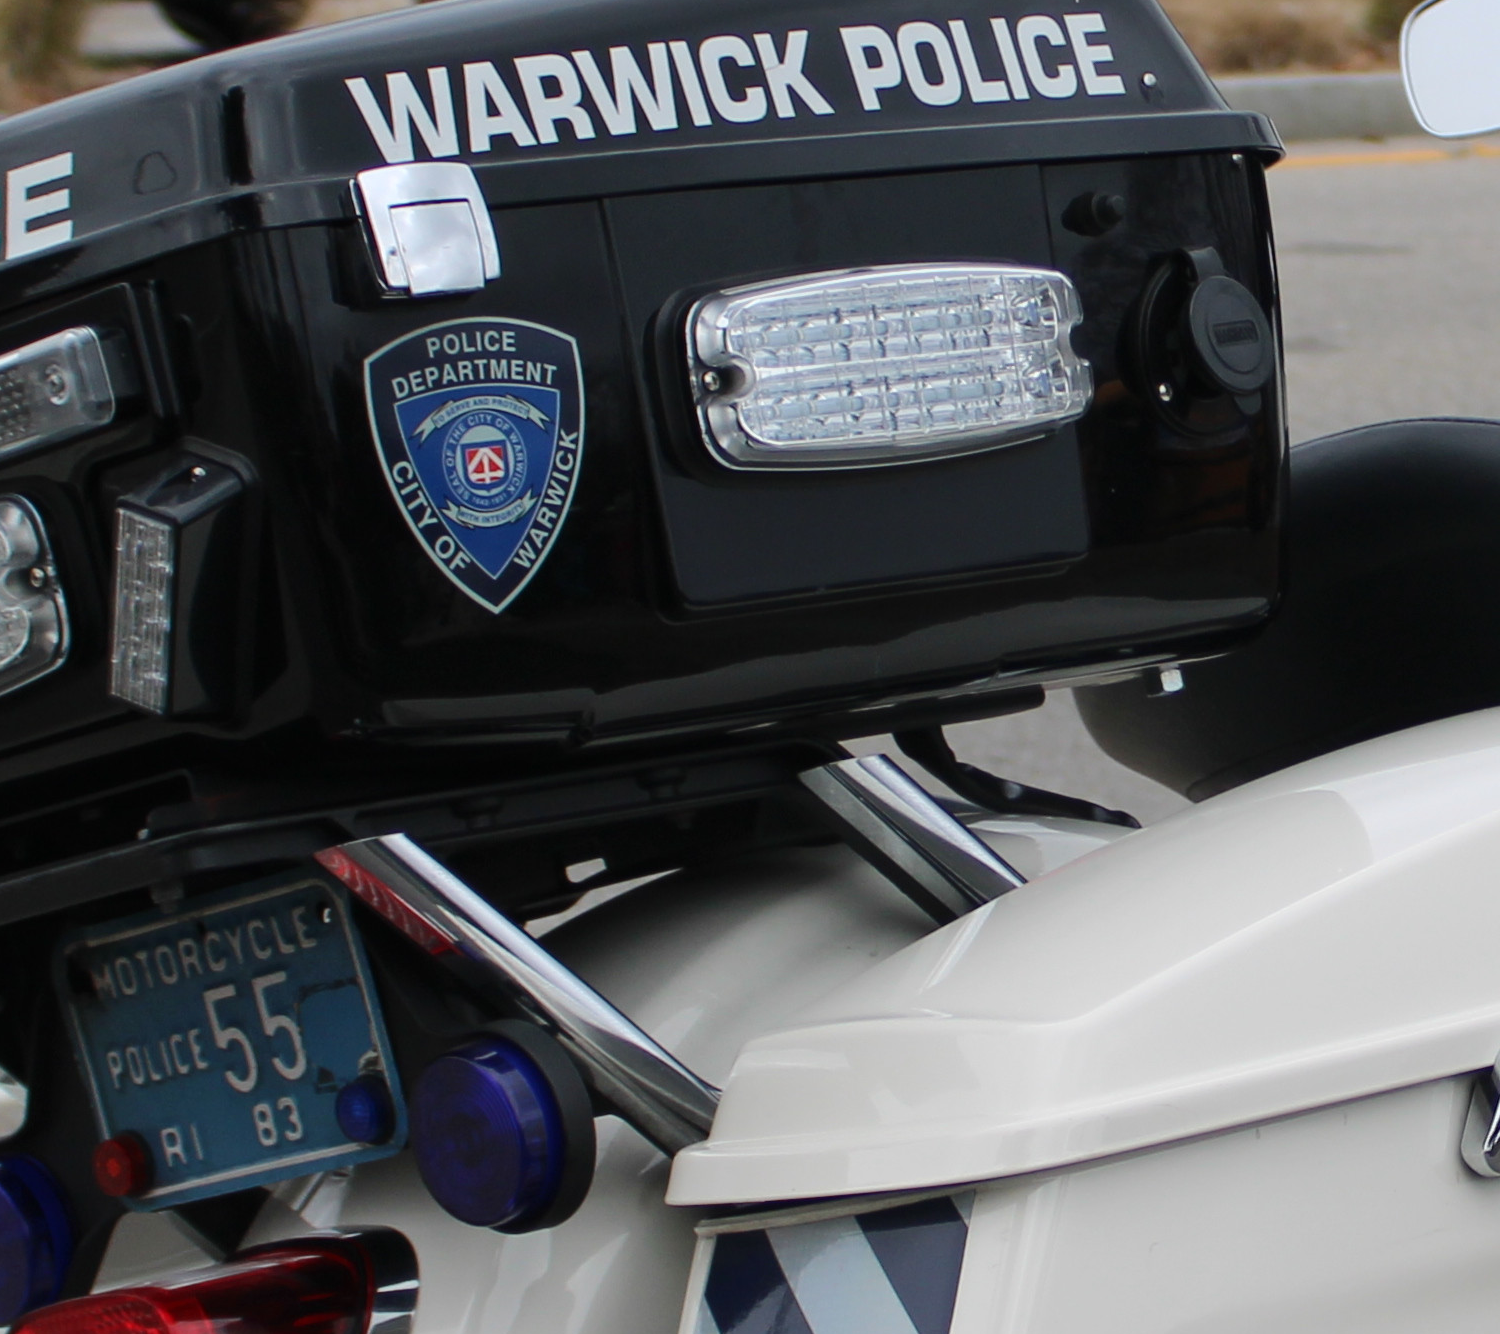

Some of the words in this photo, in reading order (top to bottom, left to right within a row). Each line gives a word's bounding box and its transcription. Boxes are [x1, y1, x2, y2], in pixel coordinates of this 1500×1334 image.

[345, 29, 834, 164] WARWICK
[840, 12, 1126, 113] POLICE
[391, 359, 557, 399] DEPARTMENT
[426, 331, 517, 358] POLICE
[449, 471, 471, 501] SEAL
[467, 412, 493, 427] CITY
[495, 417, 511, 432] OF
[513, 427, 578, 569] WARWICK
[392, 460, 438, 530] CITY
[434, 535, 471, 571] OF
[91, 905, 317, 999] MOTORCYCLE
[106, 1028, 209, 1089] POLICE
[203, 970, 307, 1093] 55
[160, 1123, 203, 1167] RI
[253, 1096, 303, 1147] 83
